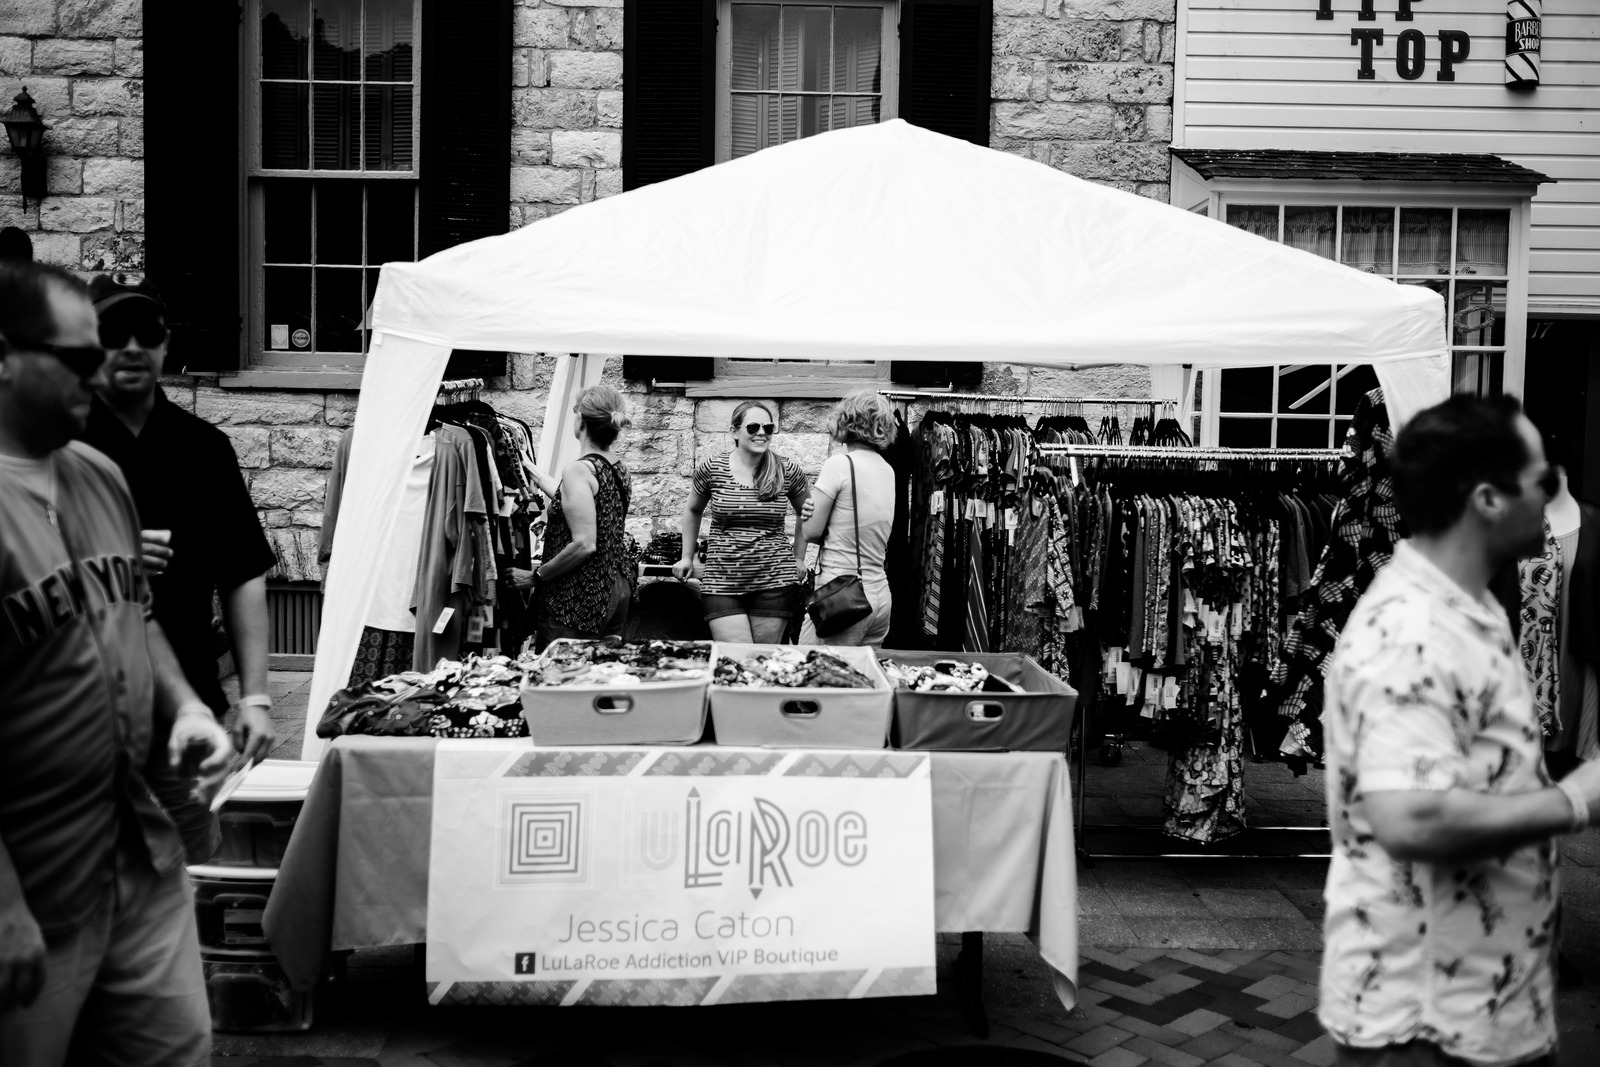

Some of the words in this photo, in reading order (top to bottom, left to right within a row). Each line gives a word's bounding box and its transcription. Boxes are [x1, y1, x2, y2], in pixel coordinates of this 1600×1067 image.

[1515, 21, 1541, 42] BARBE
[1519, 38, 1540, 50] SHOP
[1351, 28, 1471, 82] TOP
[1530, 321, 1554, 340] 17
[80, 556, 153, 618] YOR
[618, 786, 868, 900] LuLaRoe
[558, 913, 679, 943] Jessica
[695, 910, 794, 940] Caton
[541, 954, 620, 971] LuLaRoe
[624, 952, 712, 970] Addiction
[717, 949, 748, 966] VIP
[754, 948, 839, 966] Boutique
